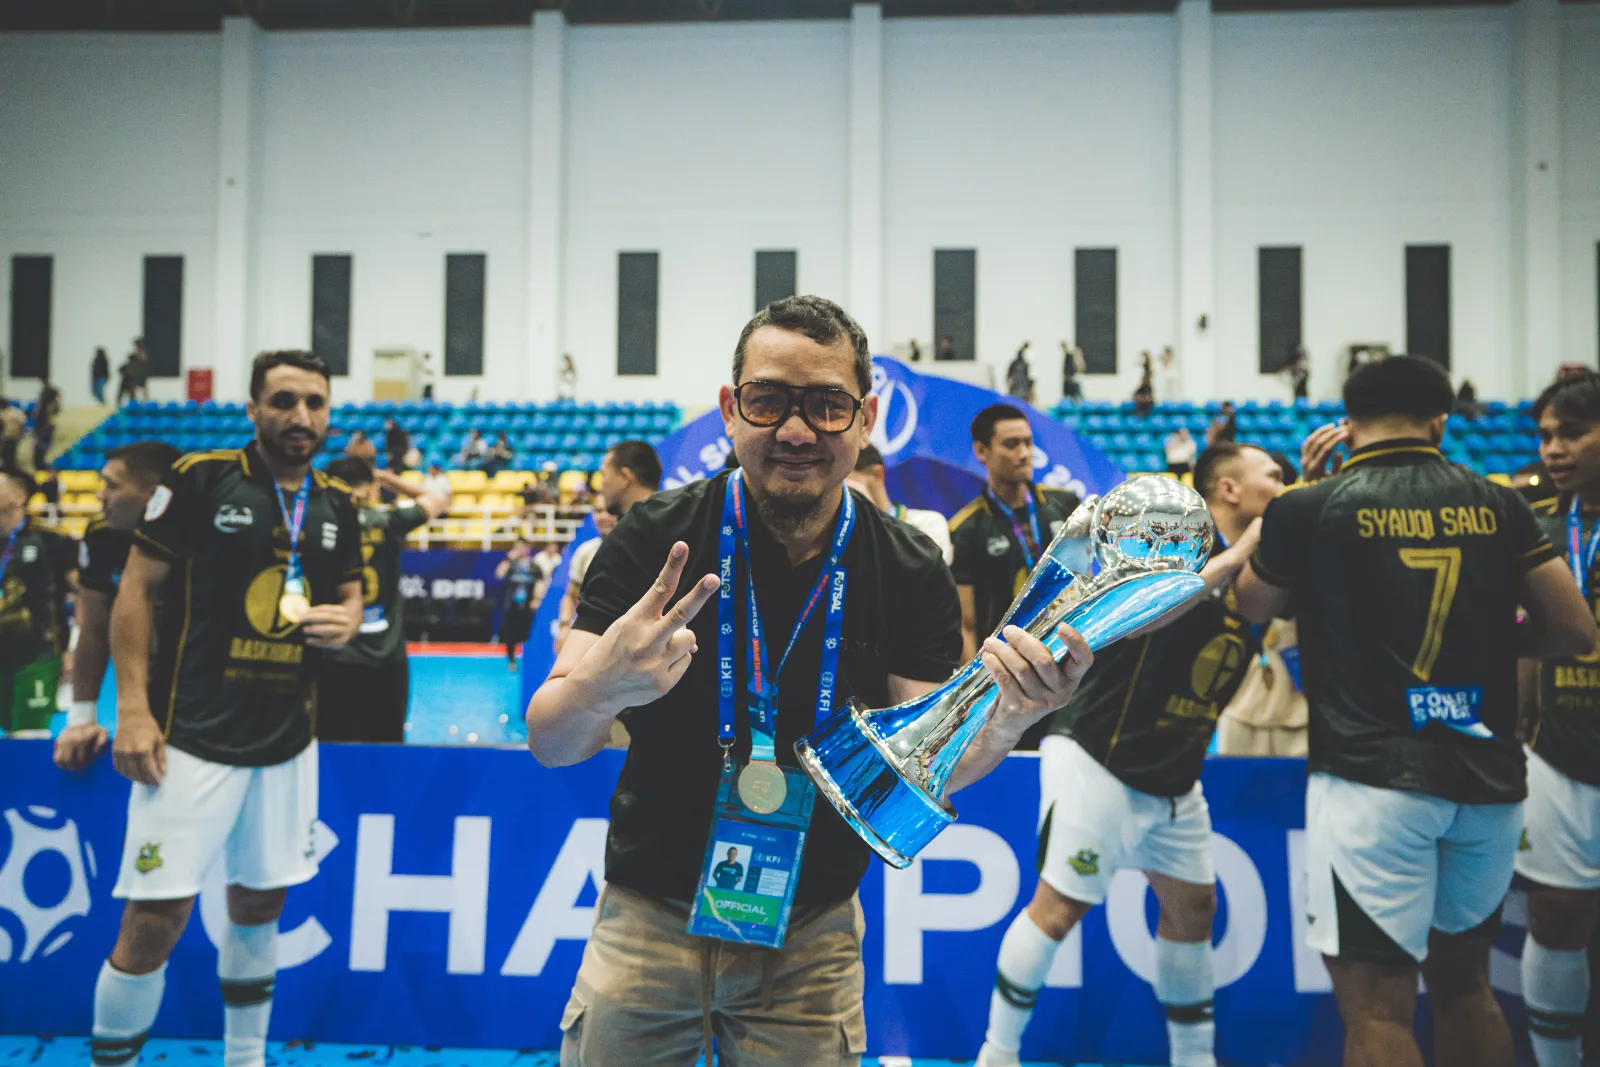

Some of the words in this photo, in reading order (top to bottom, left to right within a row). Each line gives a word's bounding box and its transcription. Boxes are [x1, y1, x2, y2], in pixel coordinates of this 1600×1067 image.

[1357, 507, 1435, 541] SYAUQI
[721, 555, 731, 598] FUTSAL
[830, 571, 844, 613] FUTSAL
[1398, 547, 1461, 682] 7
[721, 657, 732, 679] KFI
[819, 689, 832, 711] KFI
[765, 855, 781, 864] KFI
[715, 900, 766, 915] OFFICIAL
